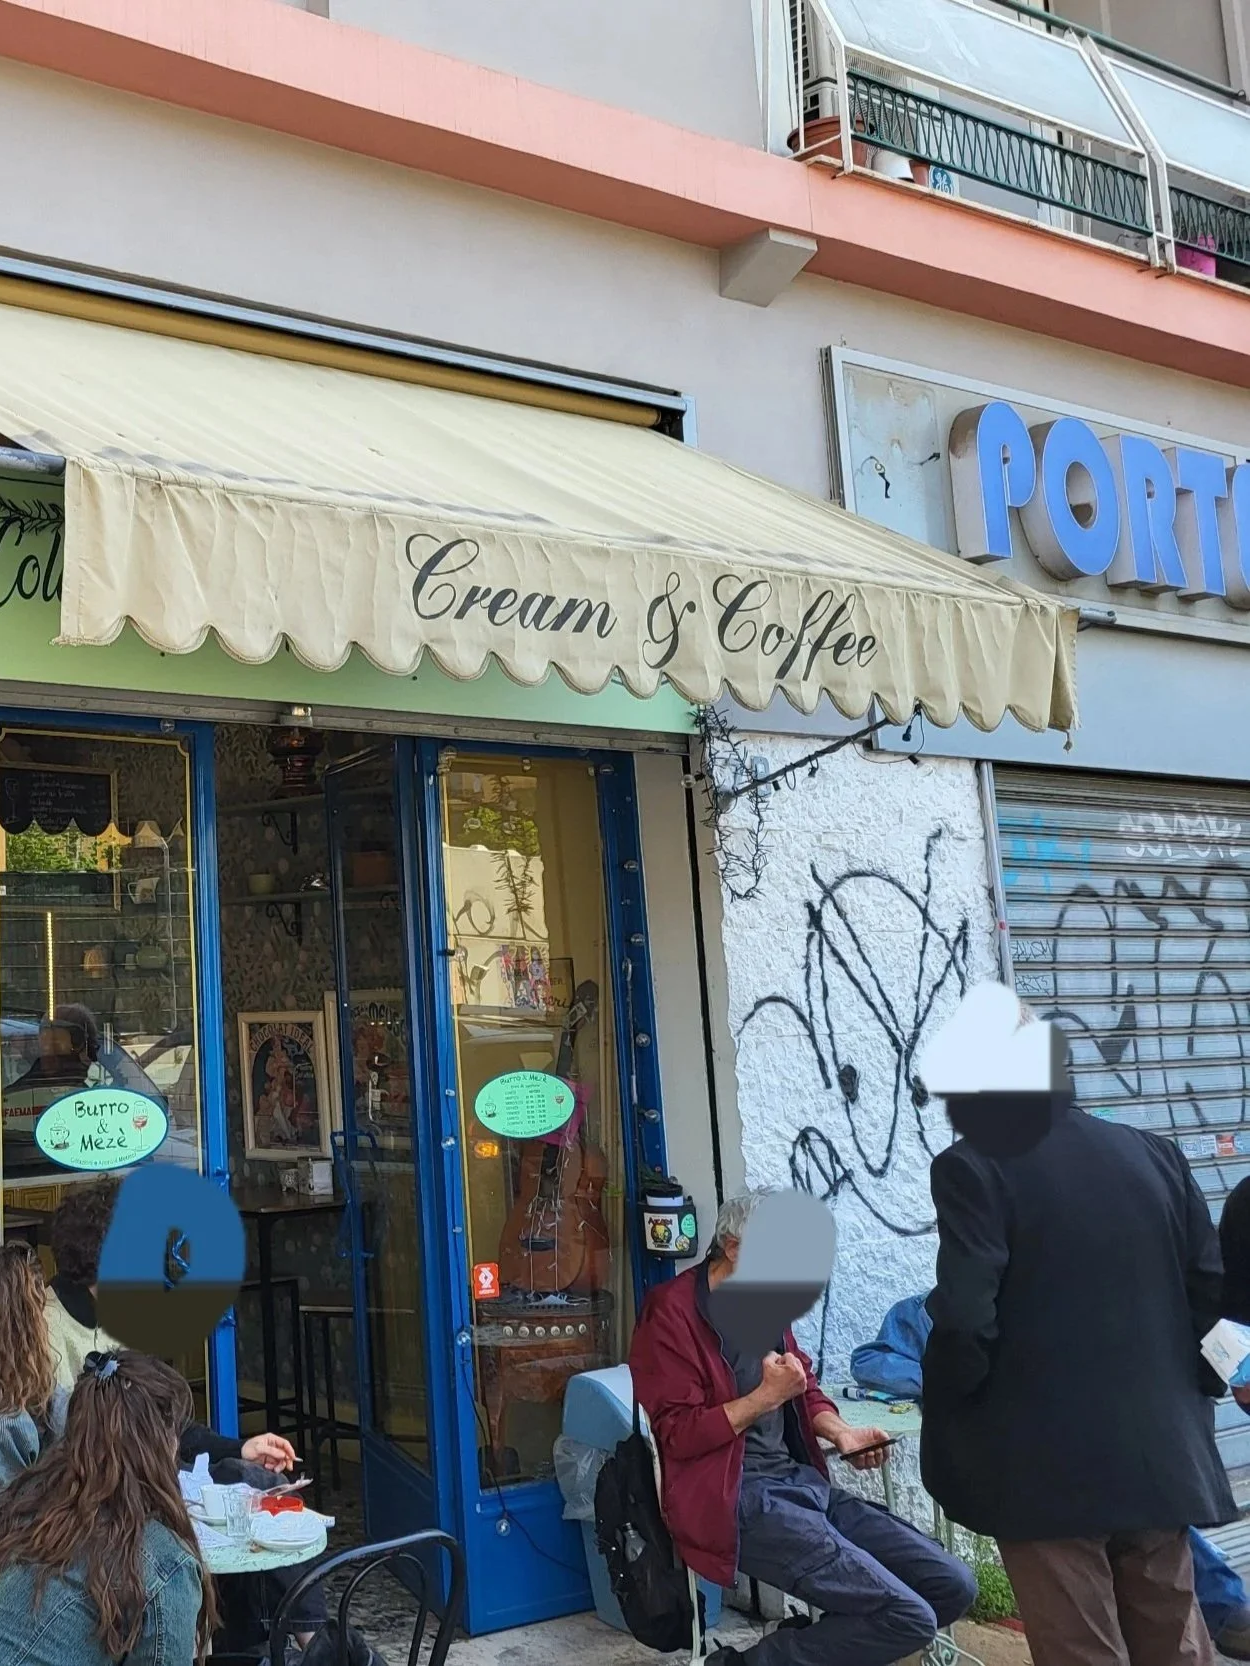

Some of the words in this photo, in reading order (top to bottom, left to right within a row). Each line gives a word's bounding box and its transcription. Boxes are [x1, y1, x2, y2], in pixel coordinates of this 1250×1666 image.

[953, 401, 1250, 606] PORT
[406, 533, 618, 638] Cream
[644, 572, 696, 669] &
[712, 574, 878, 680] Coffee
[250, 1024, 287, 1052] CHOCOLAT
[4, 1107, 32, 1117] FAEMA
[74, 1100, 129, 1118] Burro
[97, 1119, 110, 1134] &
[79, 1128, 129, 1153] Mezè
